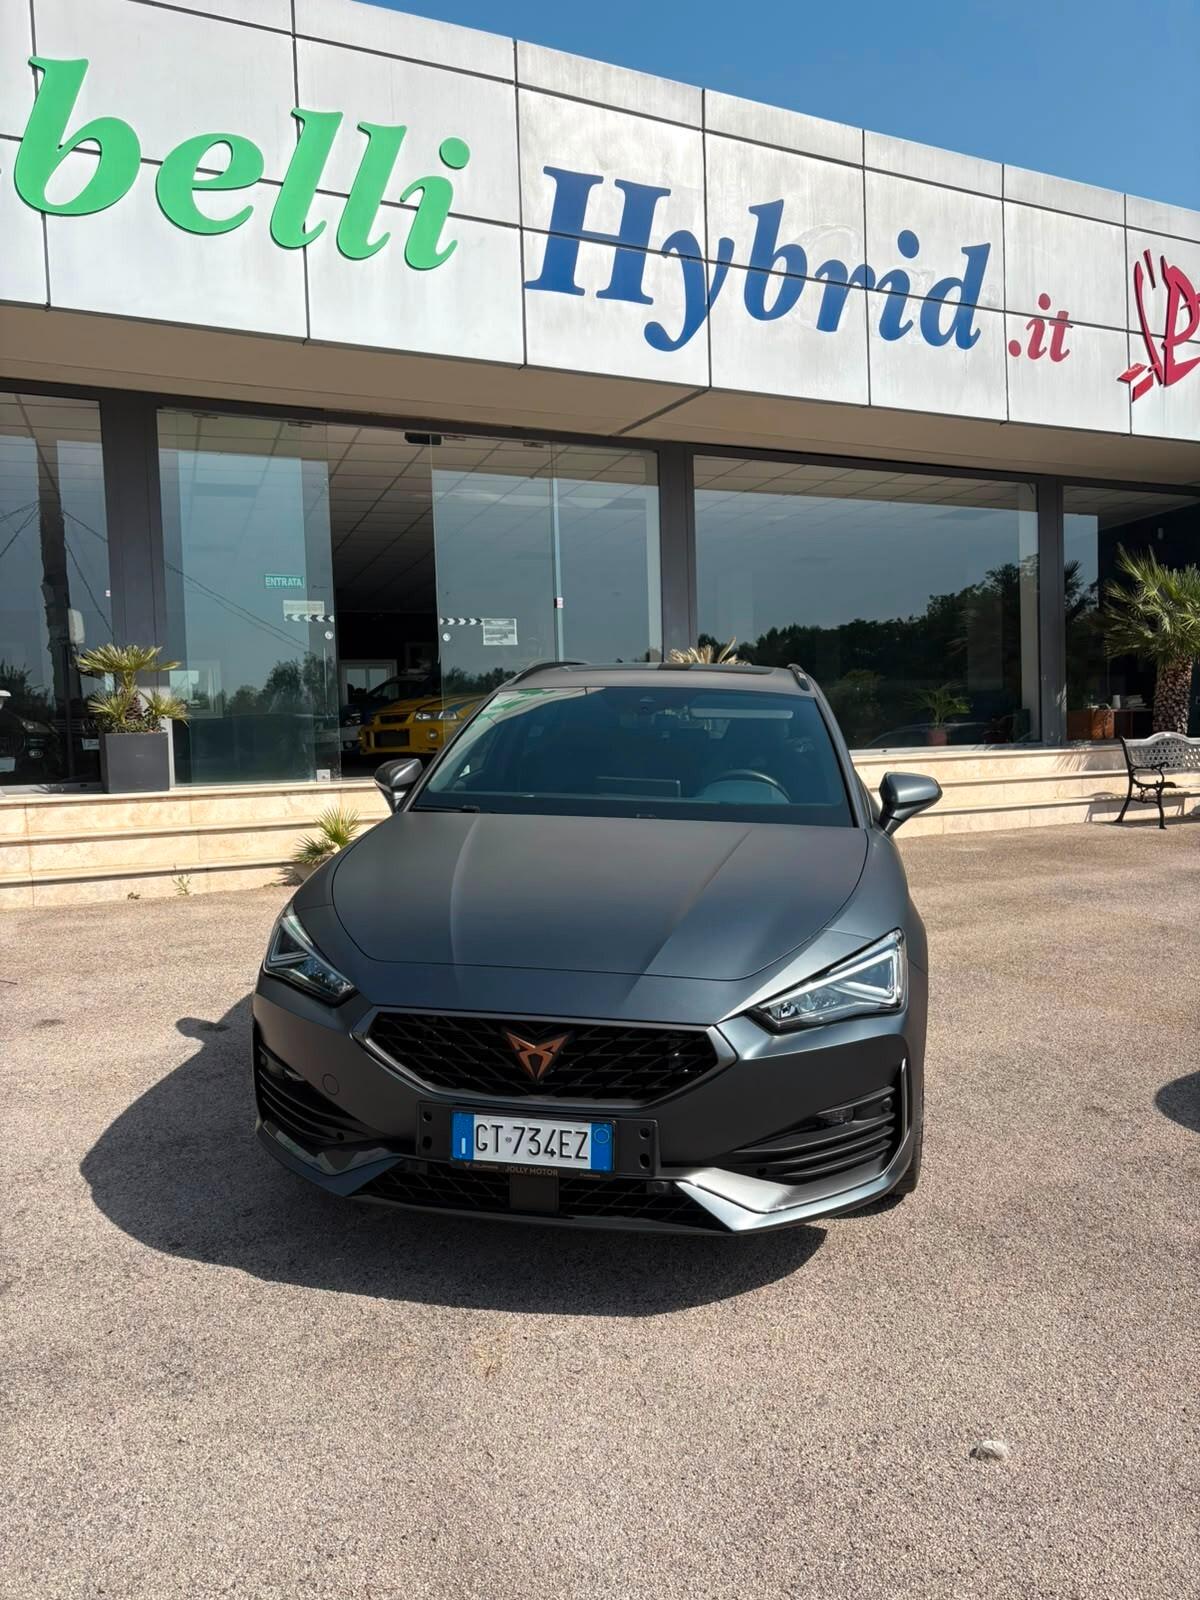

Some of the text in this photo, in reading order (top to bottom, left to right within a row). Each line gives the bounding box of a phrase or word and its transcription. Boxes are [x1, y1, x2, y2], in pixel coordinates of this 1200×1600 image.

[524, 165, 992, 353] Hybrid
[265, 576, 302, 587] ENTRATA
[505, 1165, 528, 1175] JOLLY
[530, 1167, 558, 1177] MOTOR
